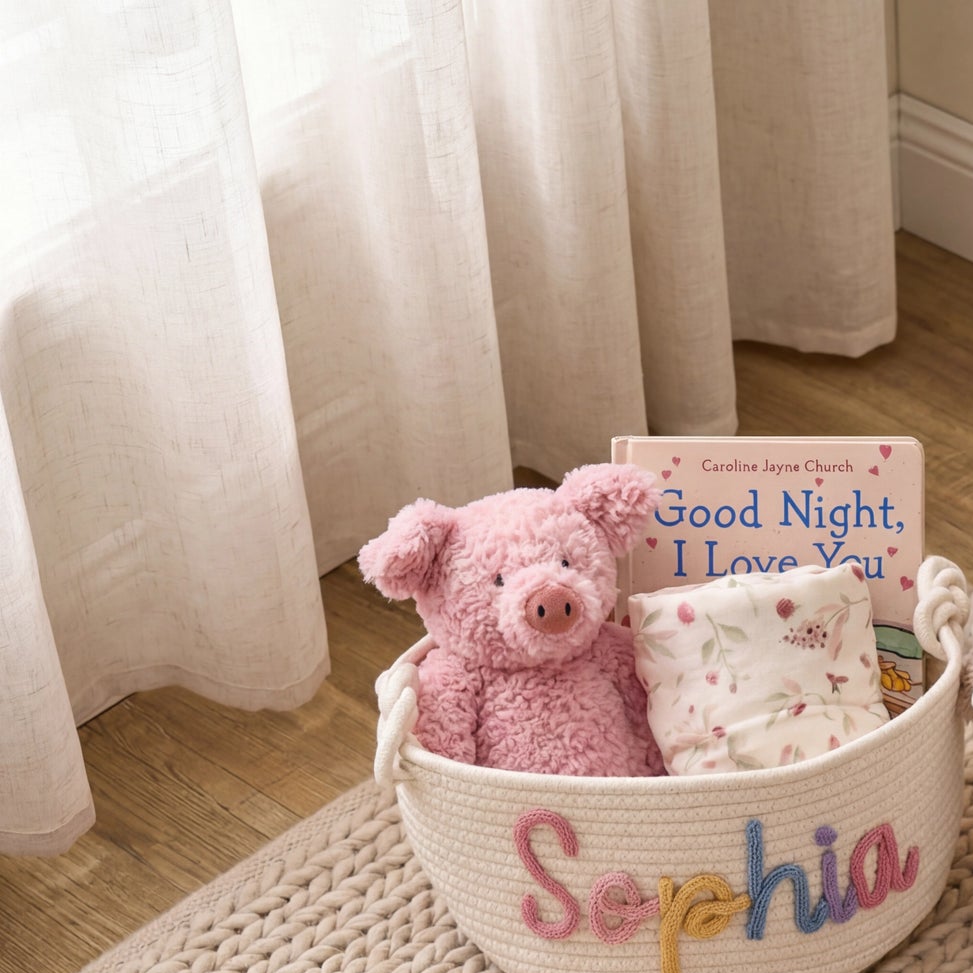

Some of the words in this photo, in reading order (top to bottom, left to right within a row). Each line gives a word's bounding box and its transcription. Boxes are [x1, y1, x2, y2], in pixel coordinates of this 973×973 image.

[701, 459, 758, 473] Caroline
[762, 459, 800, 473] Jayne
[804, 459, 854, 473] Church
[654, 489, 763, 529] Good
[779, 489, 905, 539] Night,
[673, 539, 688, 577] I
[704, 540, 799, 577] Love
